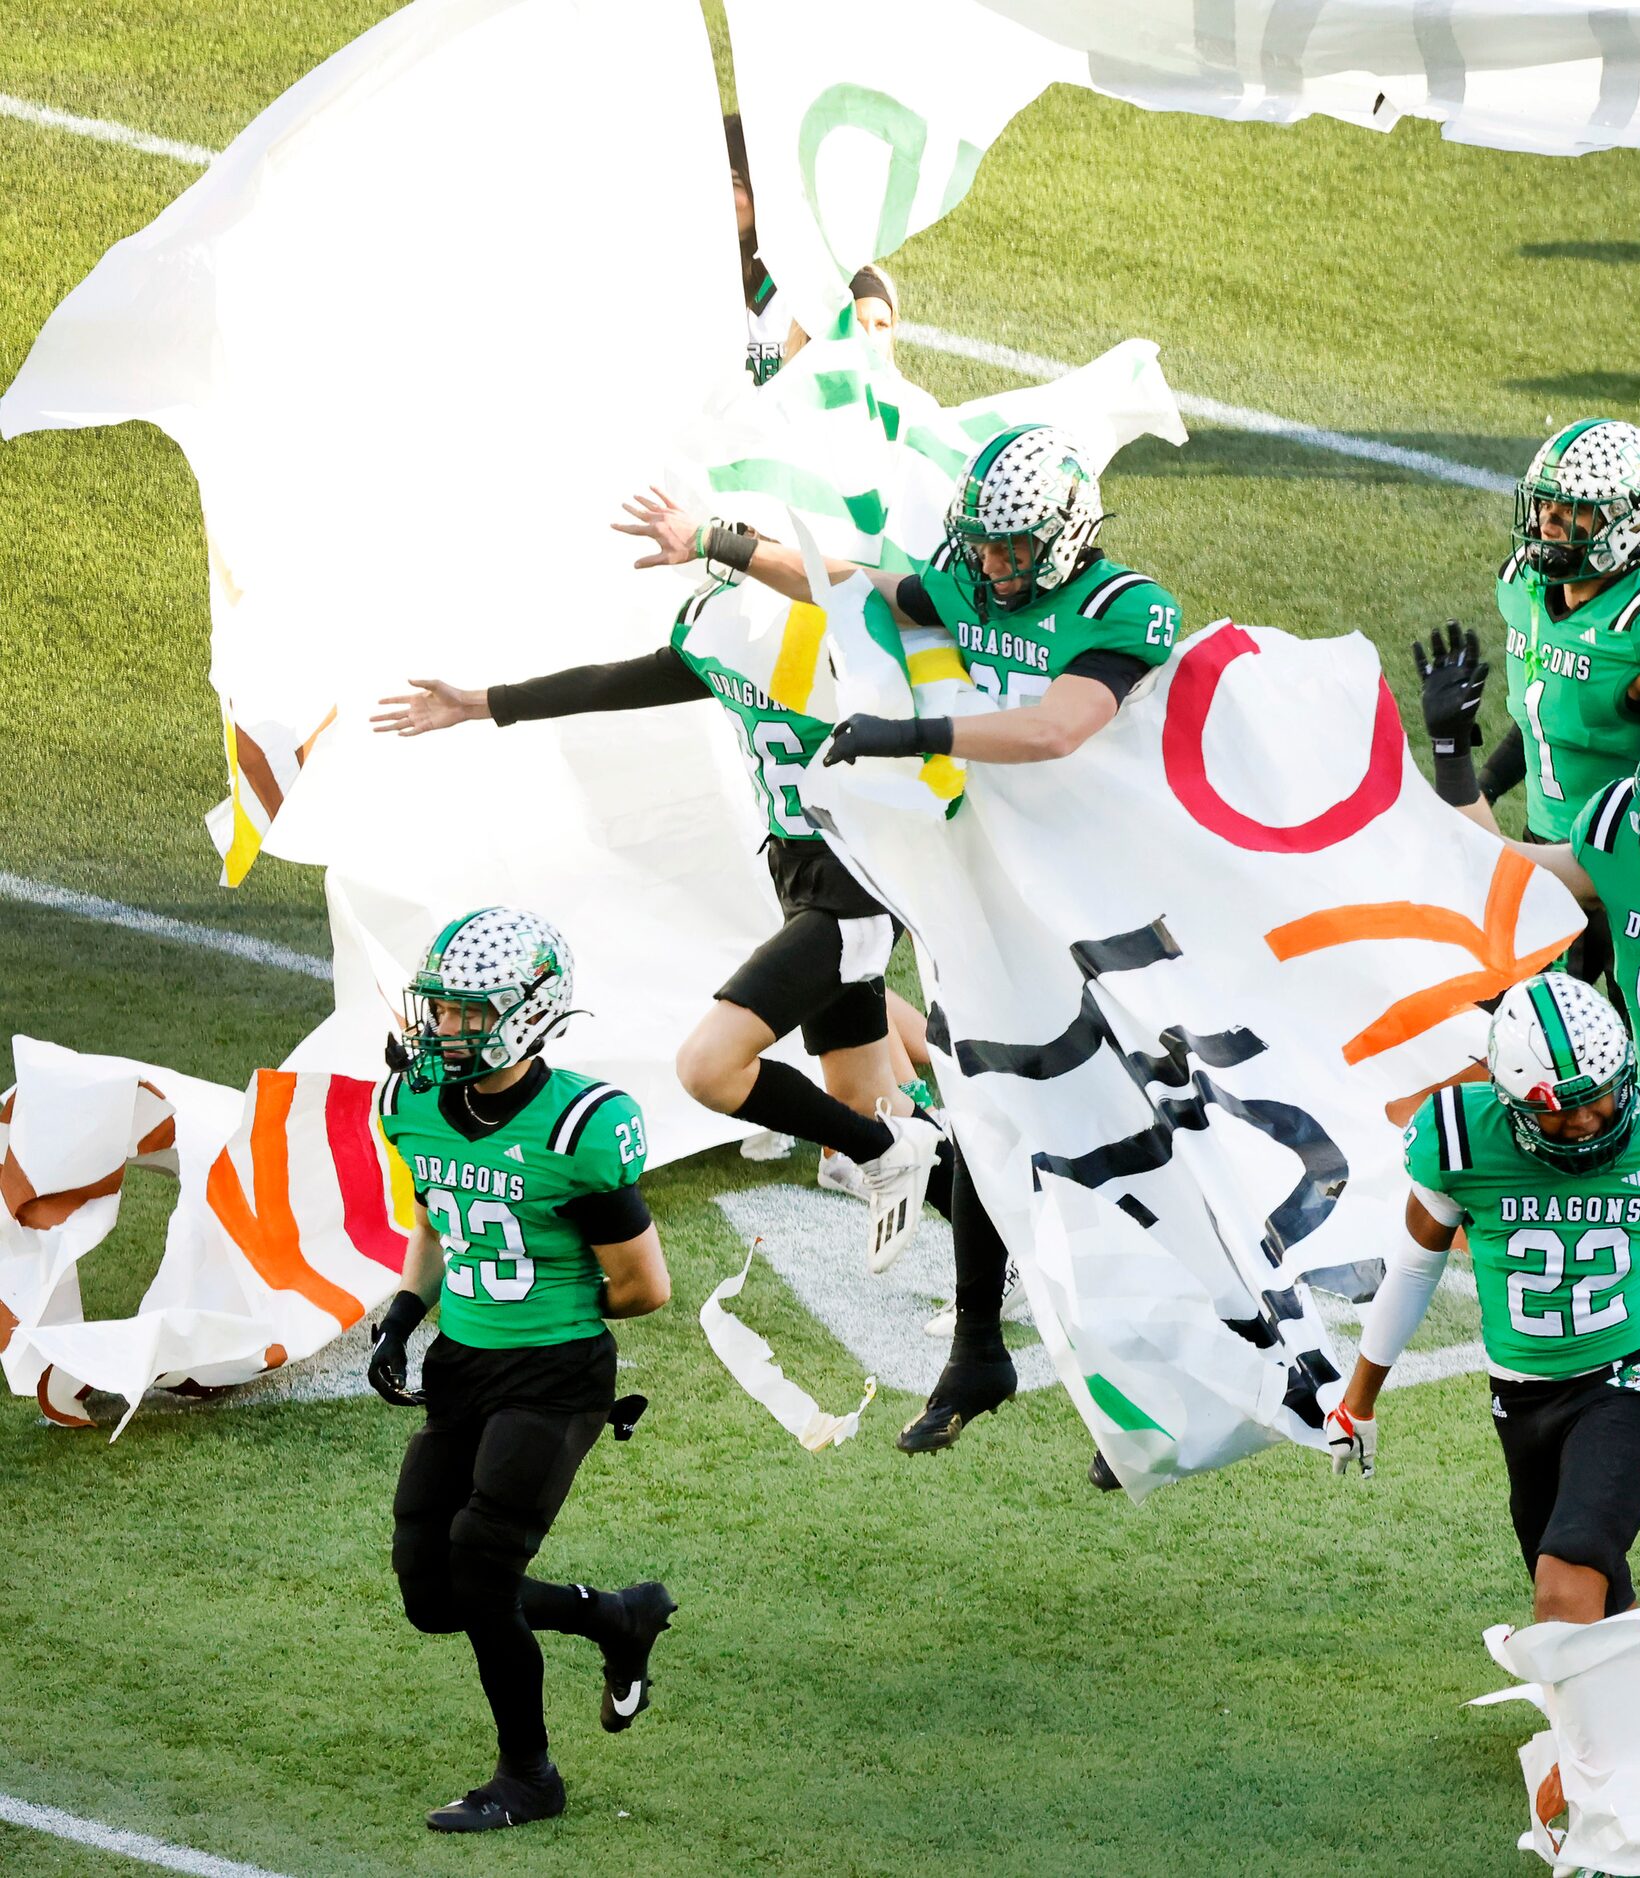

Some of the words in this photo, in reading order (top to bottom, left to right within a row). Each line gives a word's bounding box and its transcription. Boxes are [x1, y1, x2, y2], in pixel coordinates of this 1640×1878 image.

[957, 621, 1050, 672] DRAGONS
[1145, 604, 1176, 648] 25
[1505, 625, 1591, 681] DRGONS
[707, 671, 789, 711] DRAGO
[1524, 679, 1565, 801] 1
[614, 1115, 647, 1165] 23
[414, 1155, 524, 1202] DRAGONS
[424, 1187, 535, 1302] 23
[1506, 1227, 1631, 1337] 22
